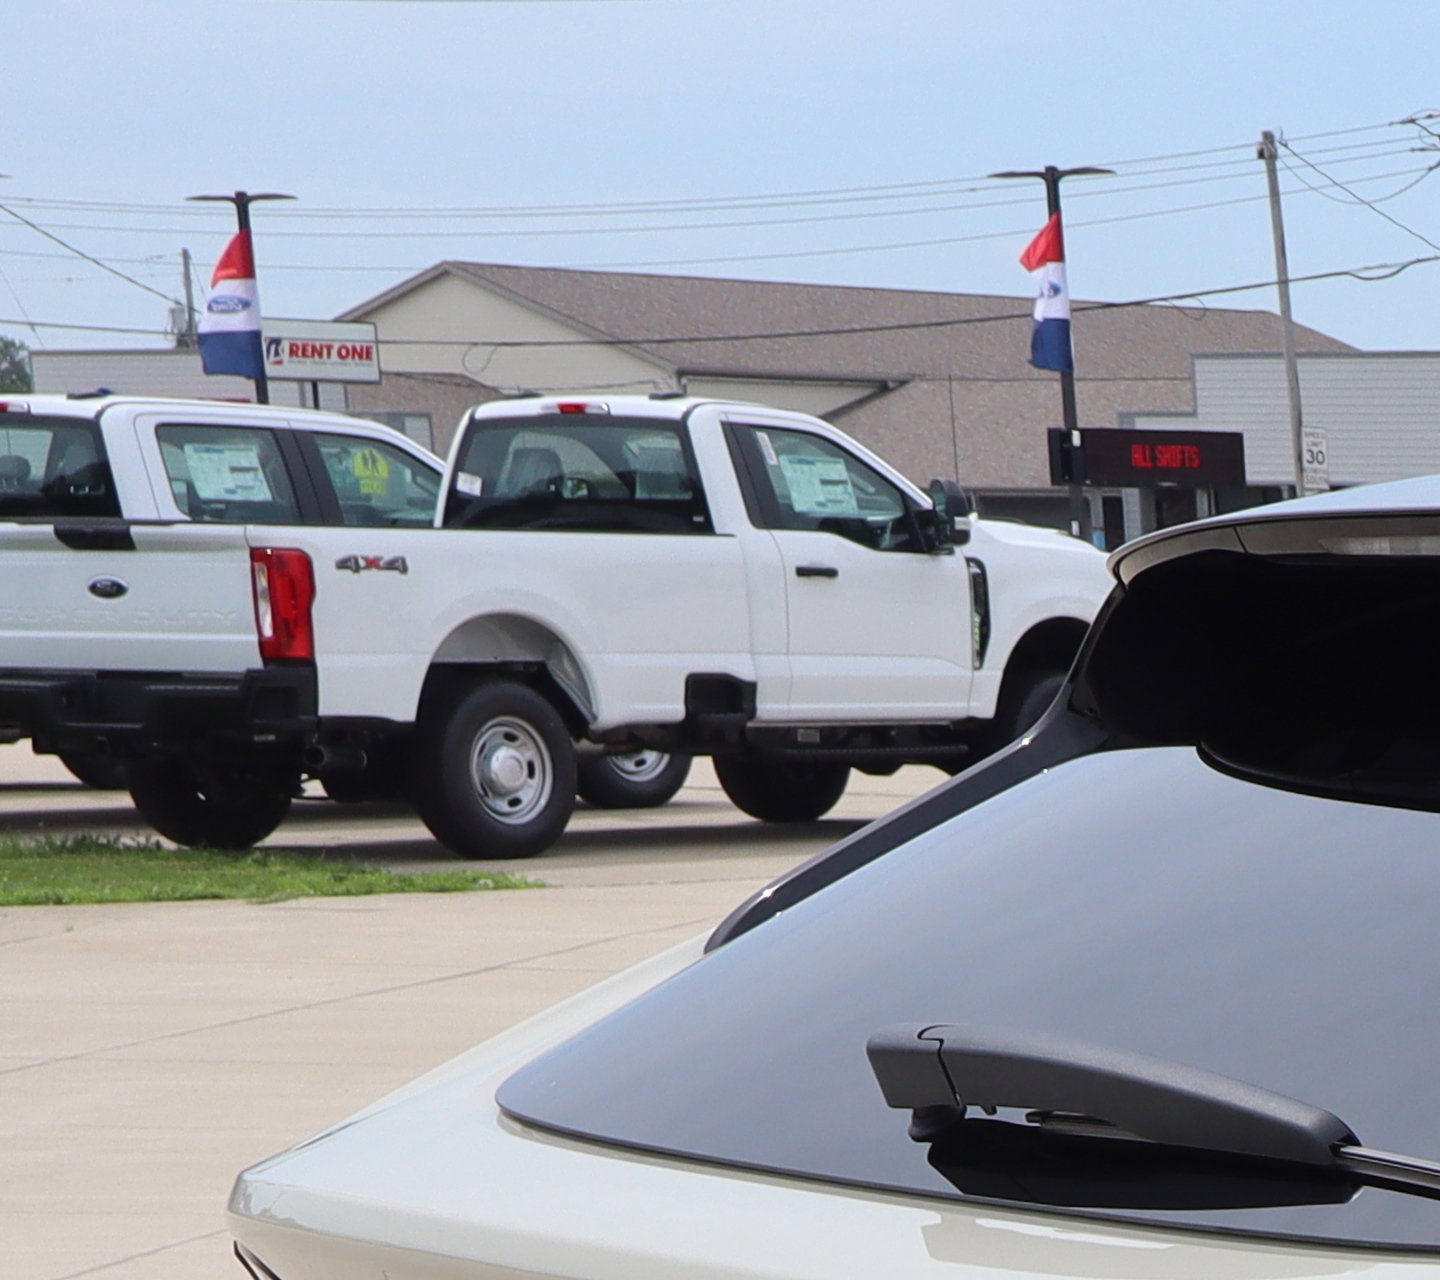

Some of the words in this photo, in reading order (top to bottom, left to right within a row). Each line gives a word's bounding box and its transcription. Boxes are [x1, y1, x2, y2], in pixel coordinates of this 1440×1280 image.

[288, 341, 333, 360] RENT
[336, 344, 373, 361] ONE
[1306, 448, 1326, 465] 30
